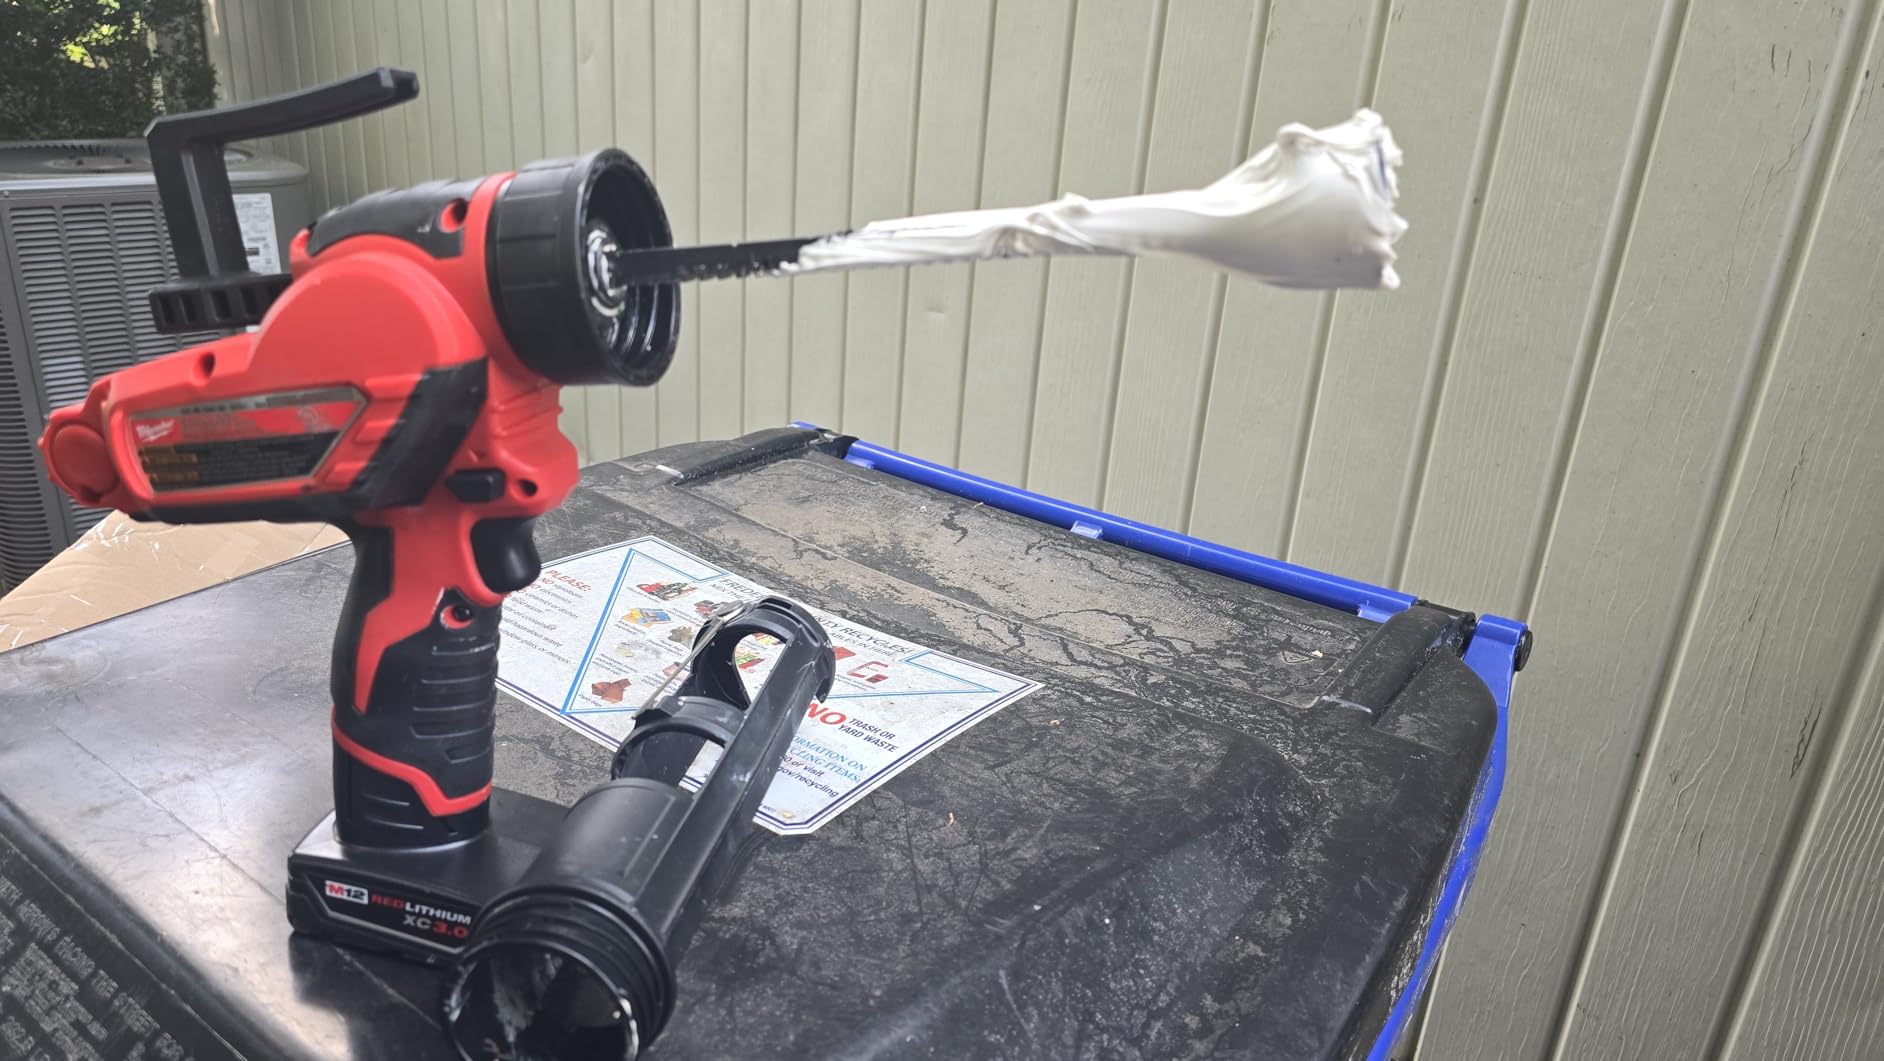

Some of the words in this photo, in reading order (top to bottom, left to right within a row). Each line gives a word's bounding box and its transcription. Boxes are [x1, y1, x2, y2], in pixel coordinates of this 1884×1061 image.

[545, 569, 592, 592] PLEASE:
[815, 616, 840, 629] NTY
[807, 703, 847, 725] NO
[838, 724, 865, 738] YARD
[863, 734, 899, 752] WASTE
[848, 718, 881, 735] TRASH
[879, 730, 896, 741] OR
[790, 746, 825, 766] CLING
[792, 735, 849, 762] ORMATION
[847, 759, 867, 772] ON
[791, 760, 805, 768] or
[803, 765, 825, 778] visit
[326, 883, 367, 901] M12
[403, 914, 431, 930] XC
[433, 921, 469, 939] 3.0
